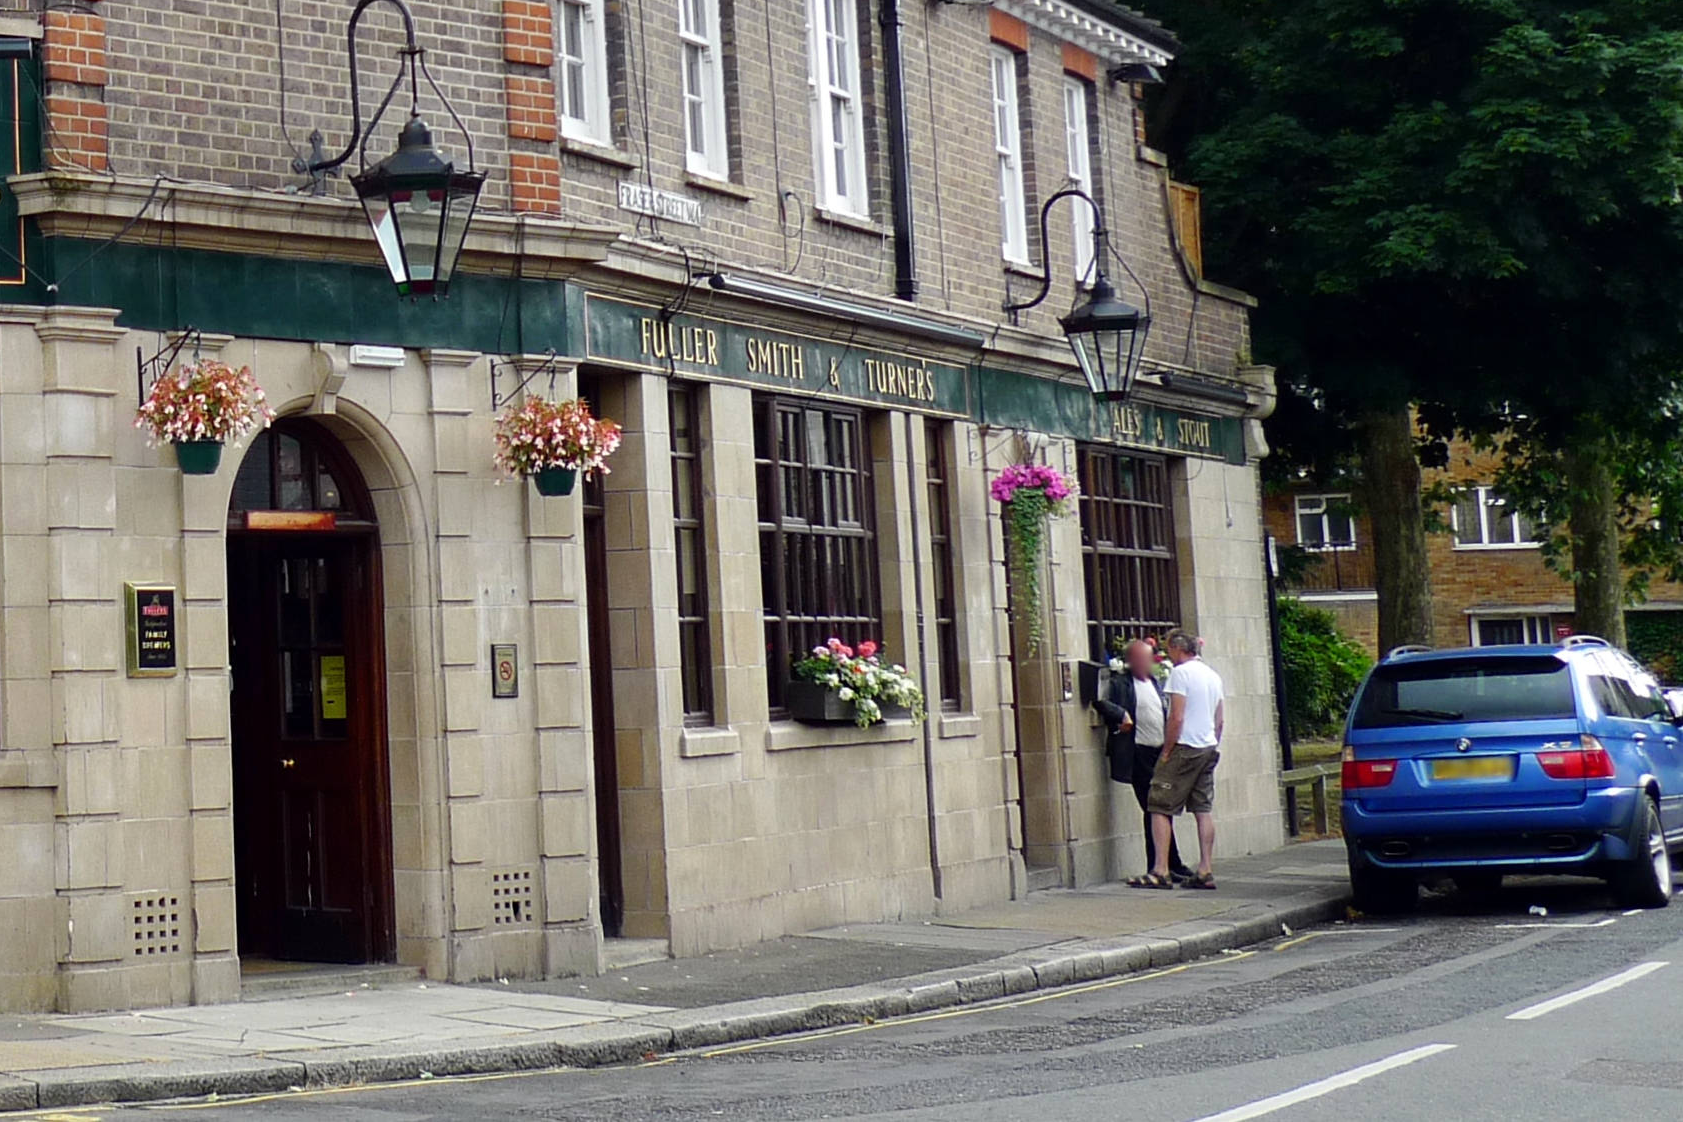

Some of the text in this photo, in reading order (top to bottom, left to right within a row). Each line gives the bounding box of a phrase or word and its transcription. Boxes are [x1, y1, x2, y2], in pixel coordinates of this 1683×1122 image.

[656, 192, 685, 221] STREET
[641, 317, 934, 402] FULLER SMITH & TURNER'S
[1113, 404, 1210, 448] ALES & STOUT
